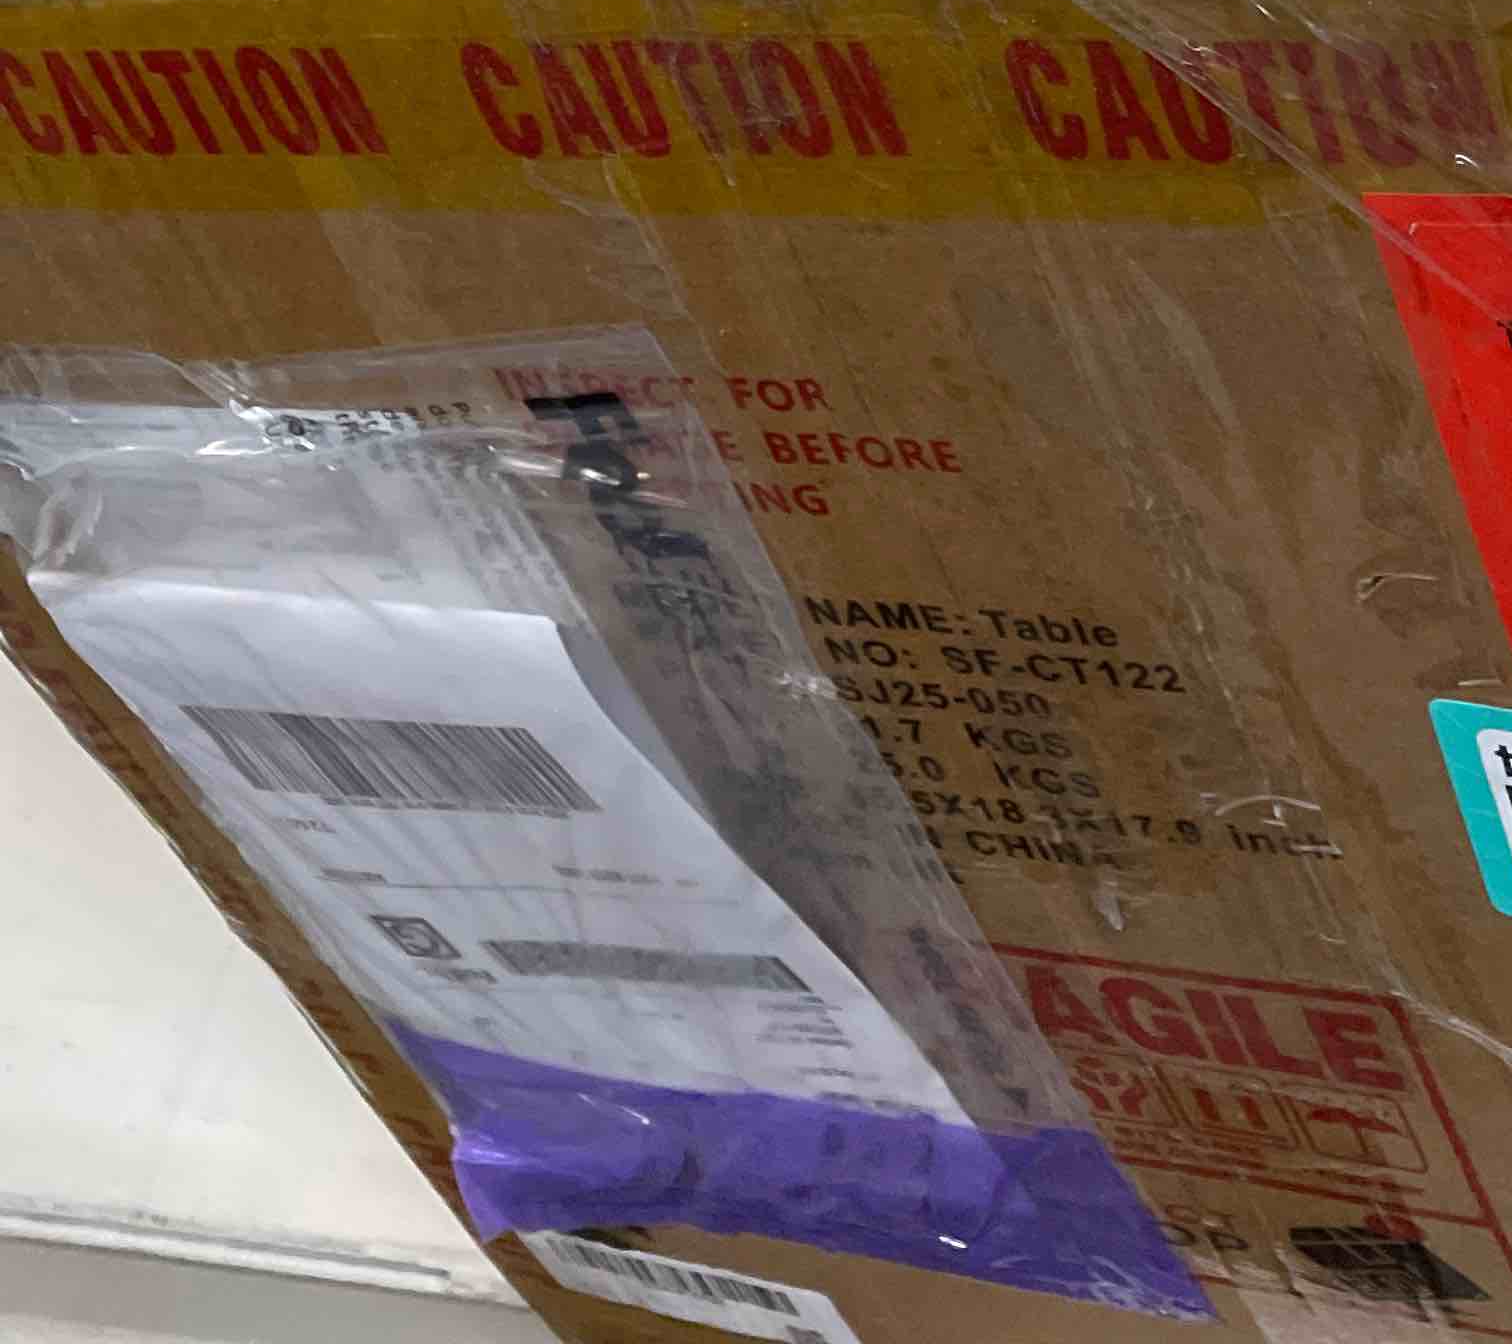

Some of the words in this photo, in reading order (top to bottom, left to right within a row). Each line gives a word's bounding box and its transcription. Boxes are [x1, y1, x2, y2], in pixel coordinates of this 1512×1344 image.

[0, 48, 390, 157] CAUTION
[459, 39, 910, 161] CAUTION
[1003, 38, 1503, 167] CAUTION
[730, 377, 835, 412] FOR
[764, 432, 964, 474] BEFORE
[804, 597, 973, 636] NAME:
[981, 611, 1120, 649] Table
[824, 638, 918, 669] NO:
[942, 647, 1186, 694] SF-CT122
[966, 722, 1074, 760] KGS
[1024, 965, 1404, 1090] AGILE
